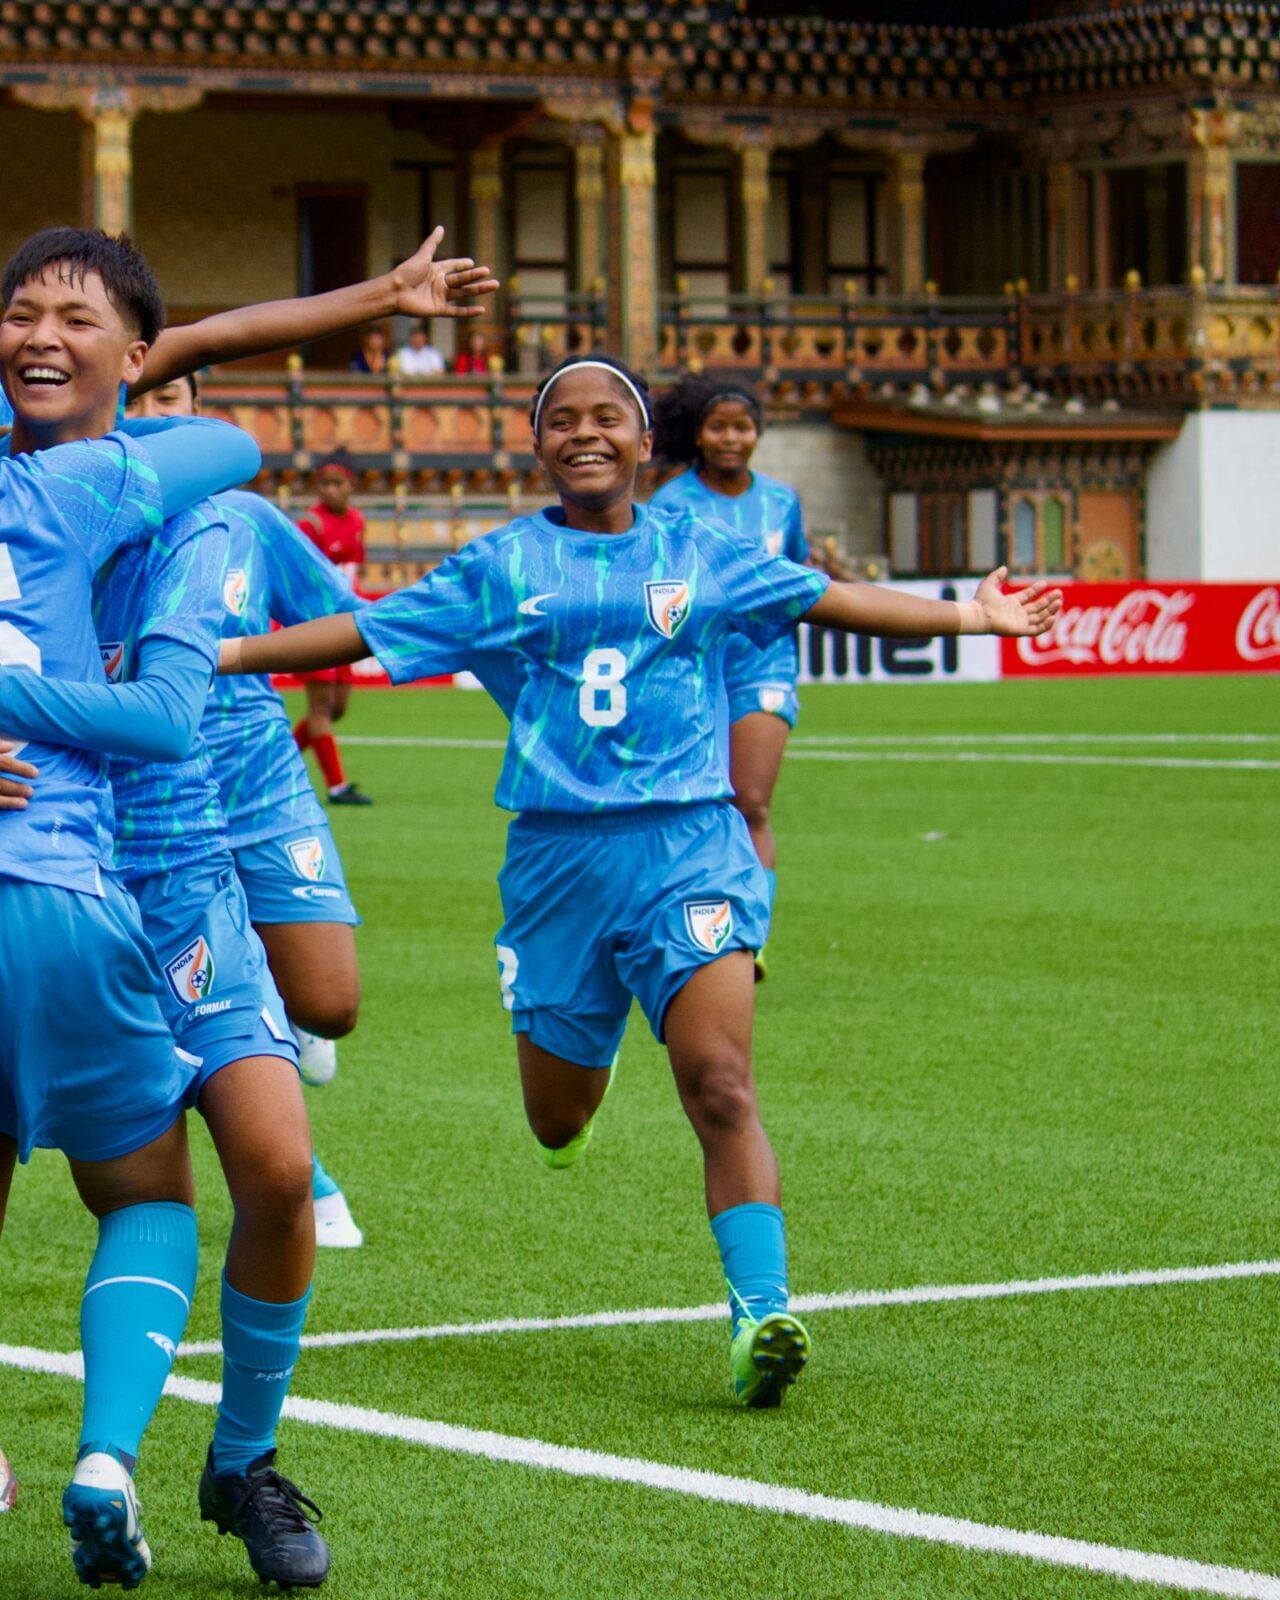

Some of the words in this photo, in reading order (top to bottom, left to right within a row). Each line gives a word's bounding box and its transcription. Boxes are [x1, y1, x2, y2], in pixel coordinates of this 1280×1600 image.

[579, 647, 627, 727] 8
[692, 907, 716, 915] INDIA
[172, 953, 195, 975] INDIA
